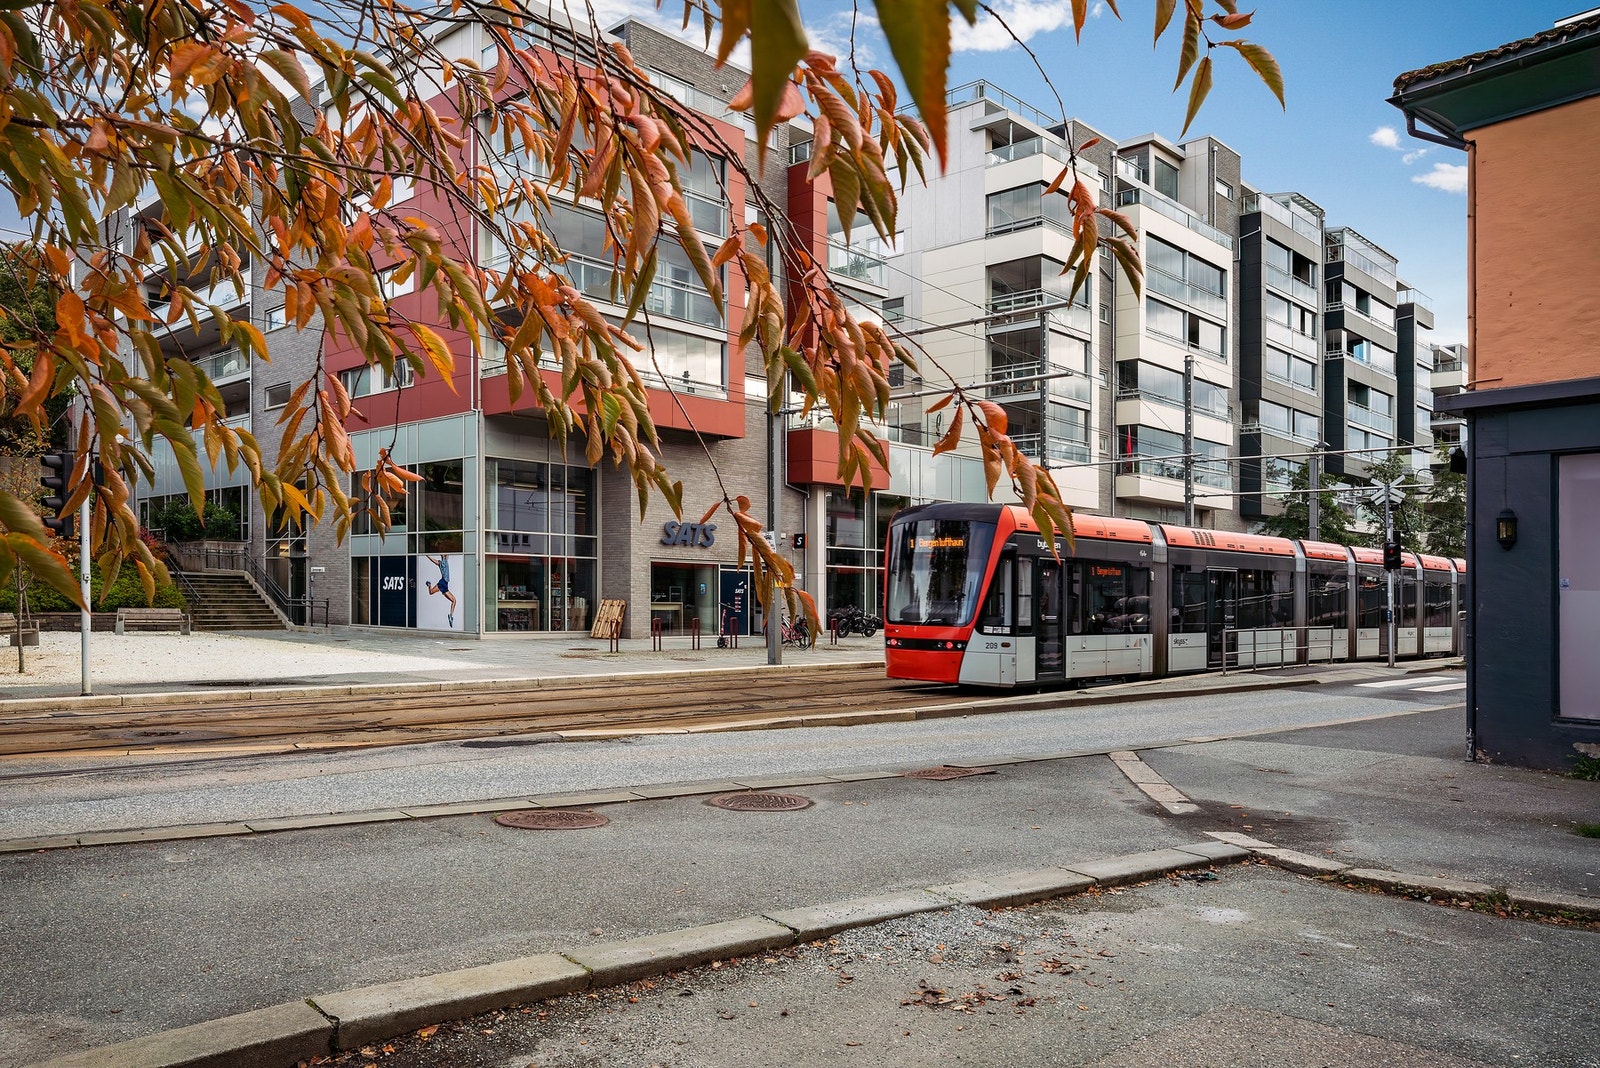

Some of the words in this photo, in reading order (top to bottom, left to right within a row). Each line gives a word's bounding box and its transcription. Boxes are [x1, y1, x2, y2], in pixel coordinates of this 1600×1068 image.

[661, 521, 717, 547] SATS
[796, 536, 803, 546] S
[382, 576, 405, 590] SATS
[985, 642, 998, 650] 209
